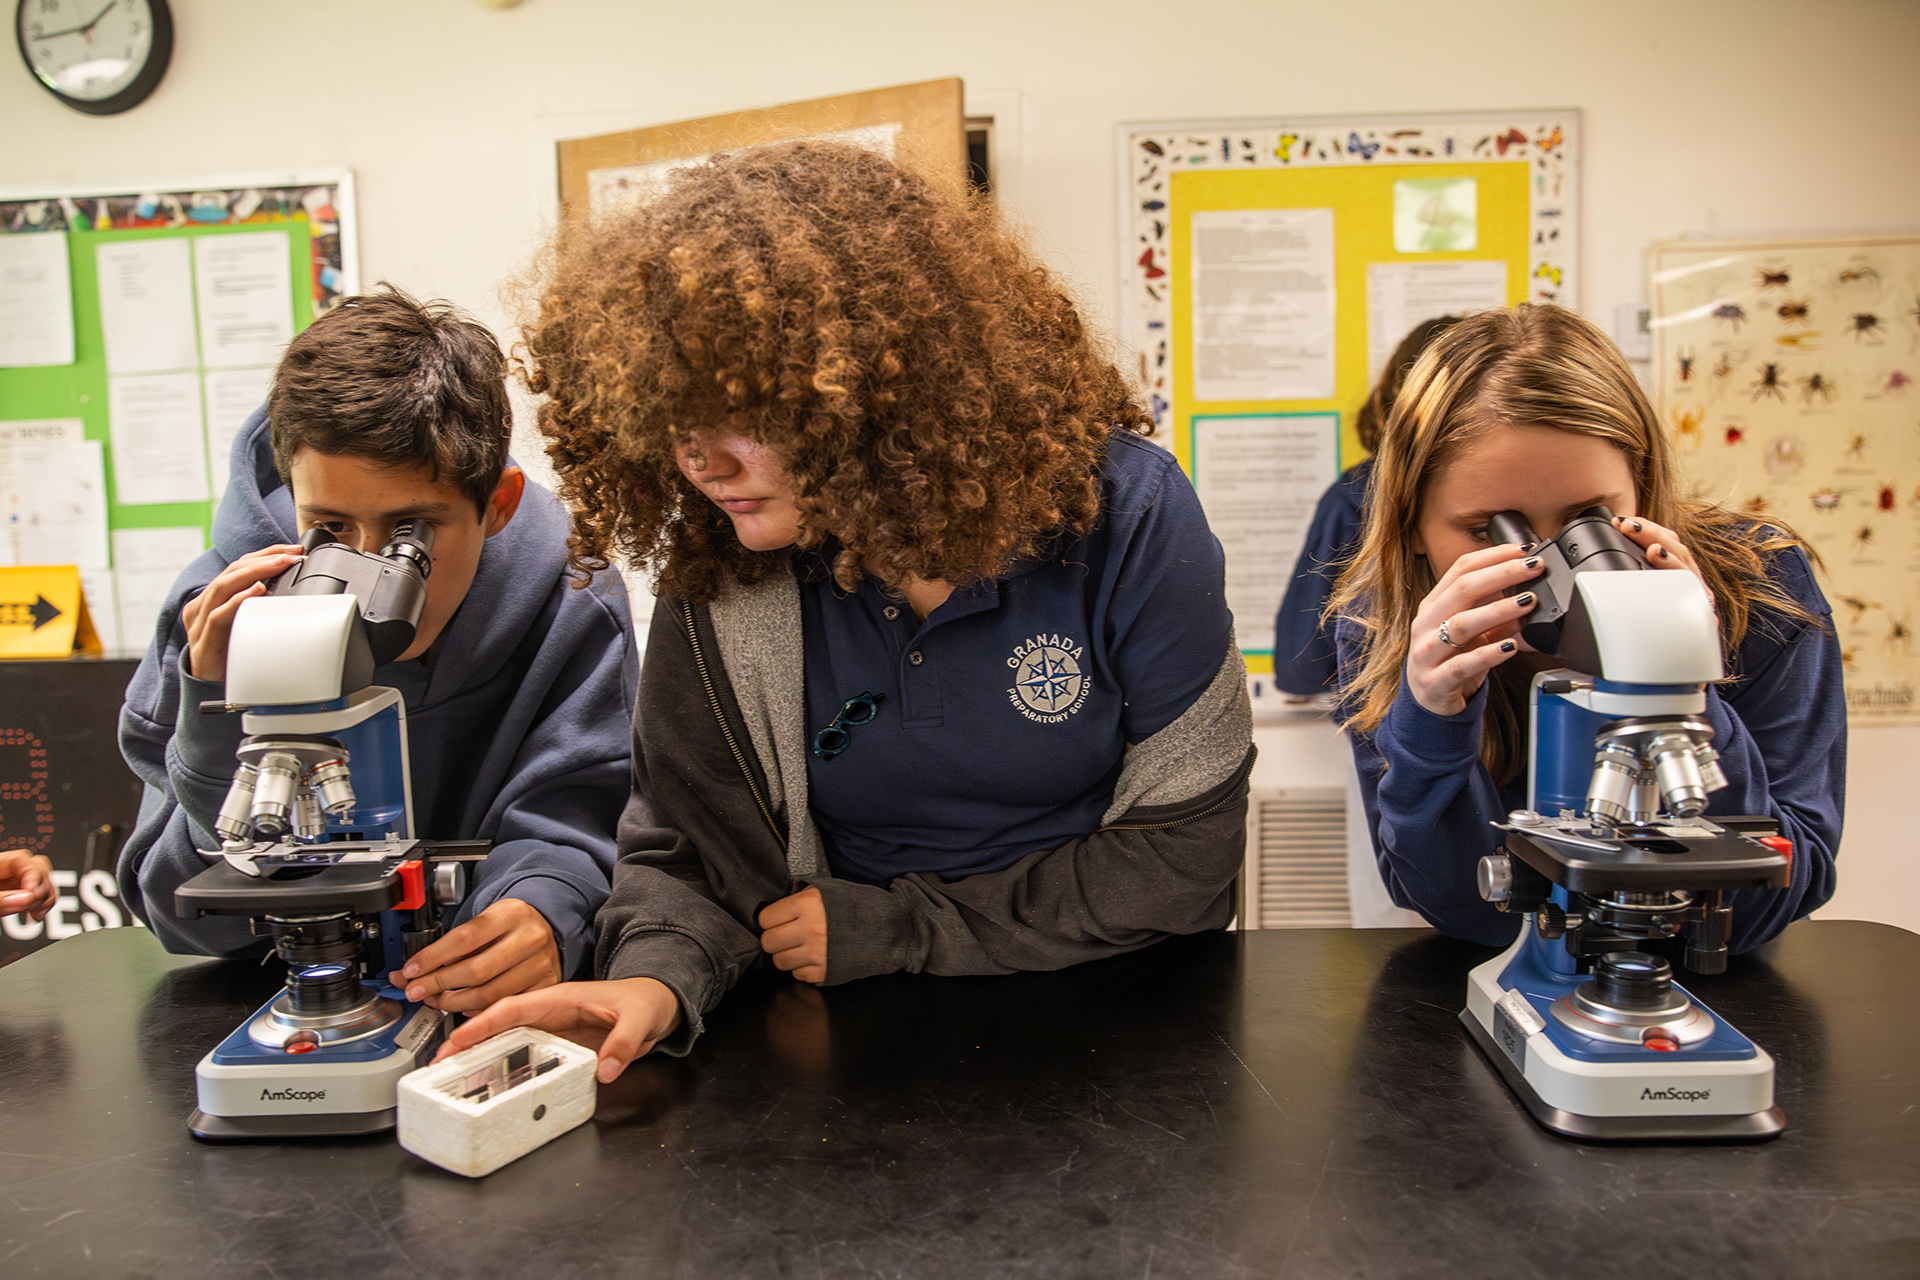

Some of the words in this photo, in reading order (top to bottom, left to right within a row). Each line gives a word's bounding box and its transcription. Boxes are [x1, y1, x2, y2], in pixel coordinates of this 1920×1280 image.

[1006, 633, 1083, 669] GRANADA
[1006, 688, 1069, 723] PREPARATORY
[1069, 675, 1091, 714] SCHOOL
[260, 1088, 326, 1103] AmScope
[1640, 1087, 1711, 1103] AmScope
